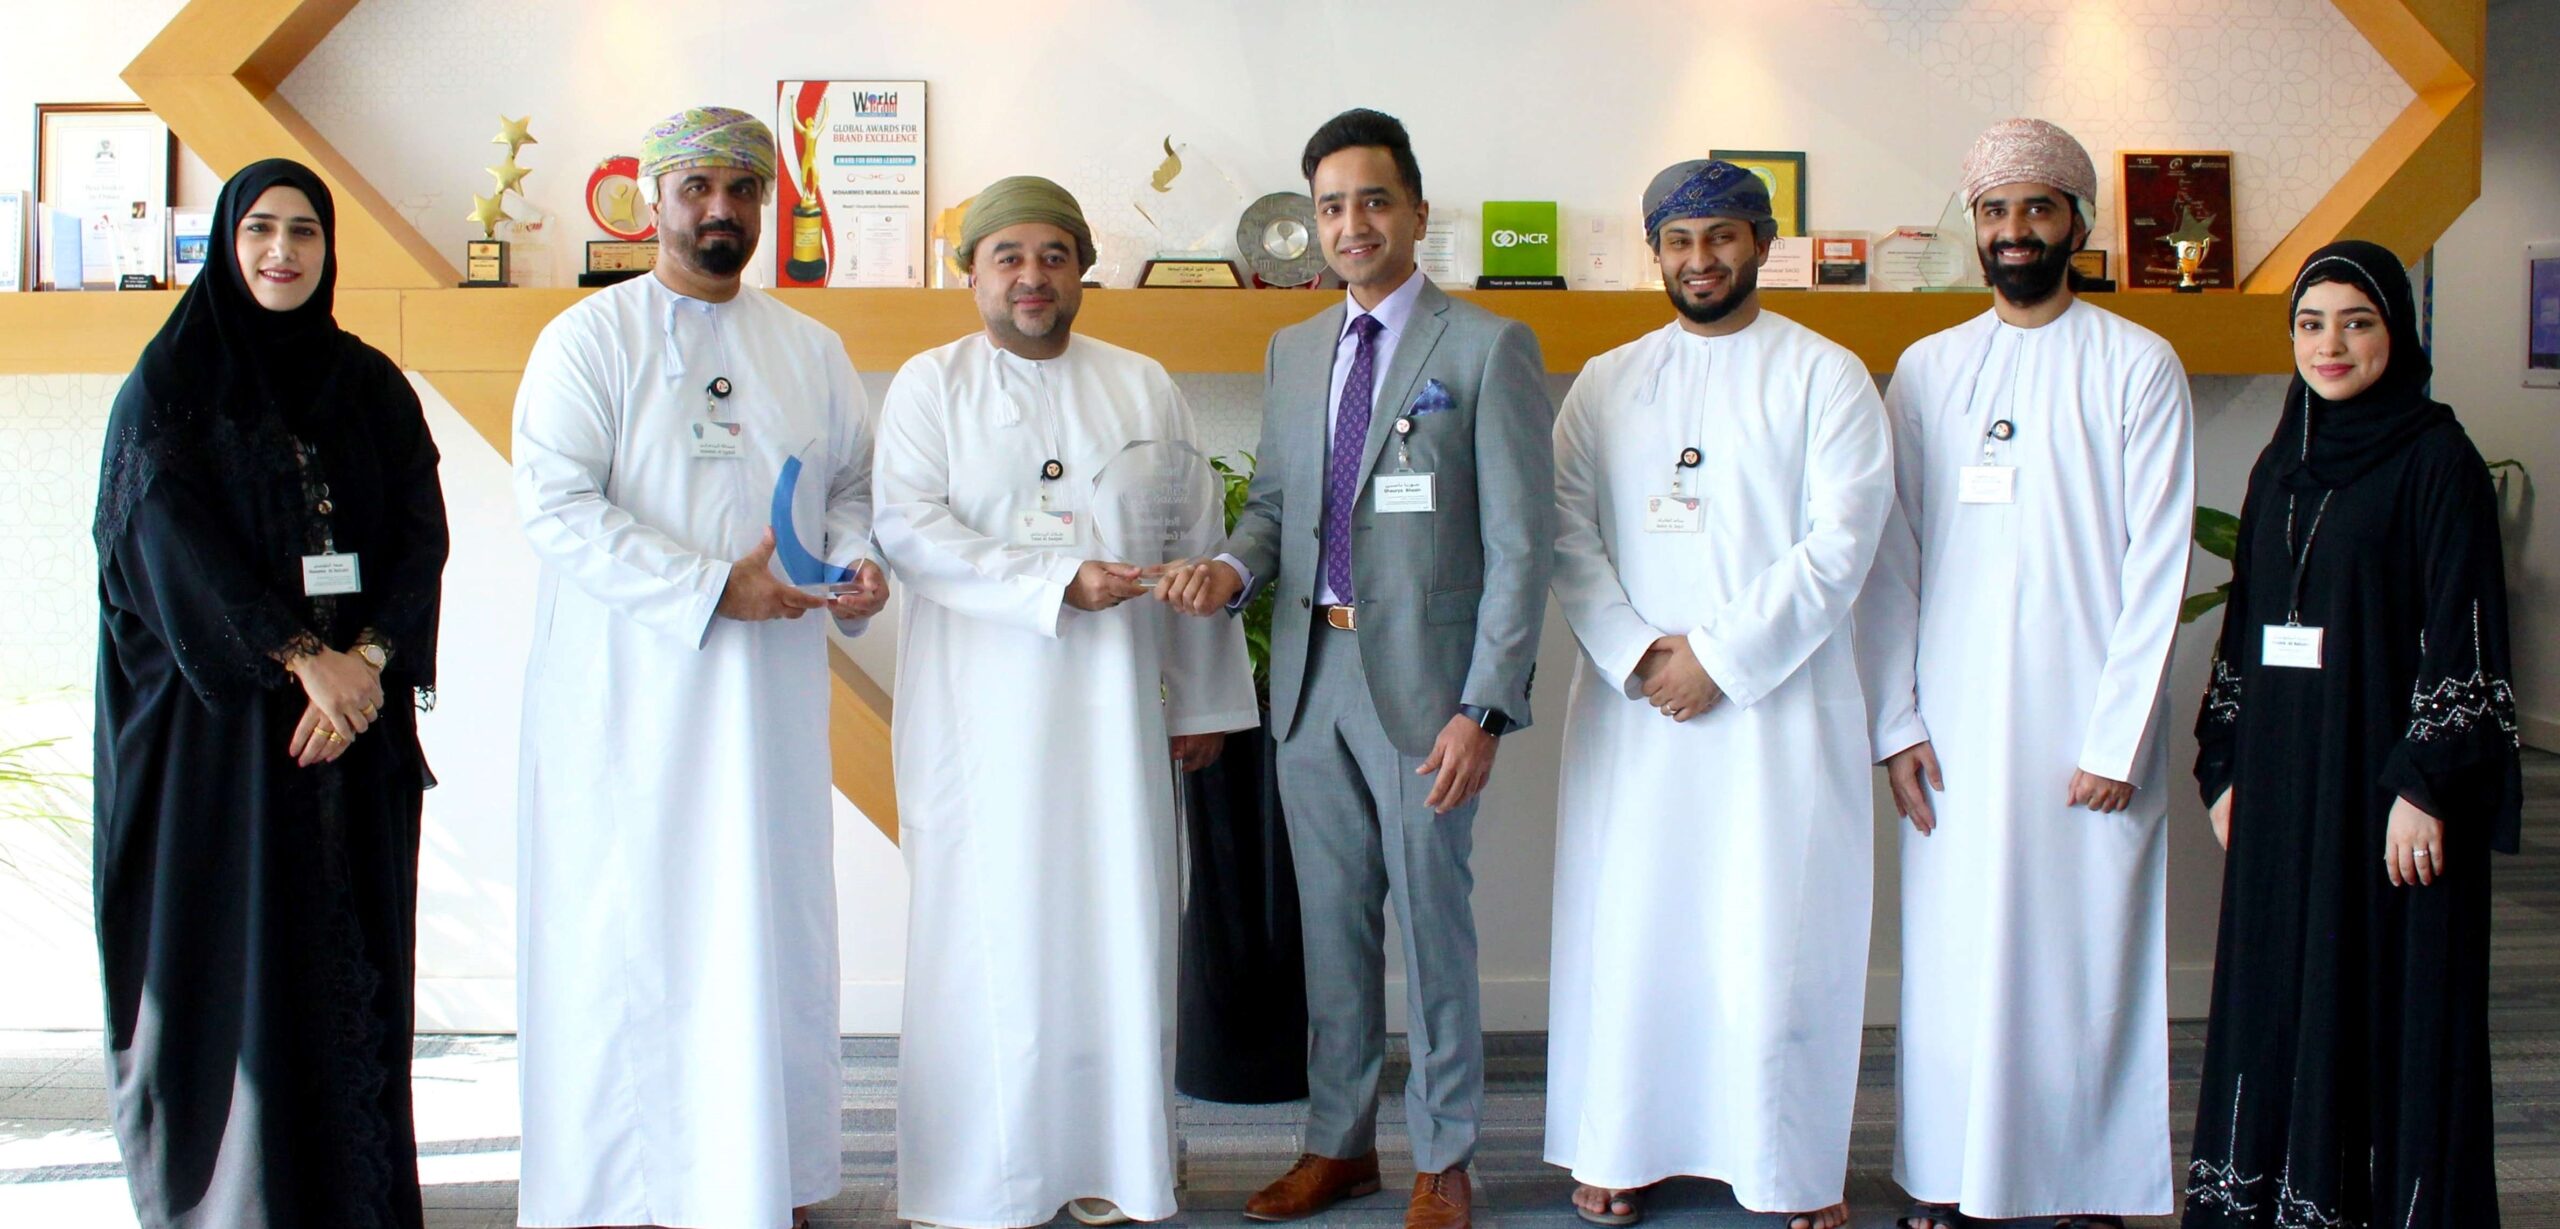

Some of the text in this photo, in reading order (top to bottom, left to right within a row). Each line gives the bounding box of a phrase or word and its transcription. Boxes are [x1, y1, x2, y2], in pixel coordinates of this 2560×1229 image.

[853, 91, 897, 112] World
[833, 124, 917, 132] GLOBAL AWARDS FOR
[833, 134, 917, 142] BRAND EXCELLENCE
[1519, 234, 1548, 244] NCR
